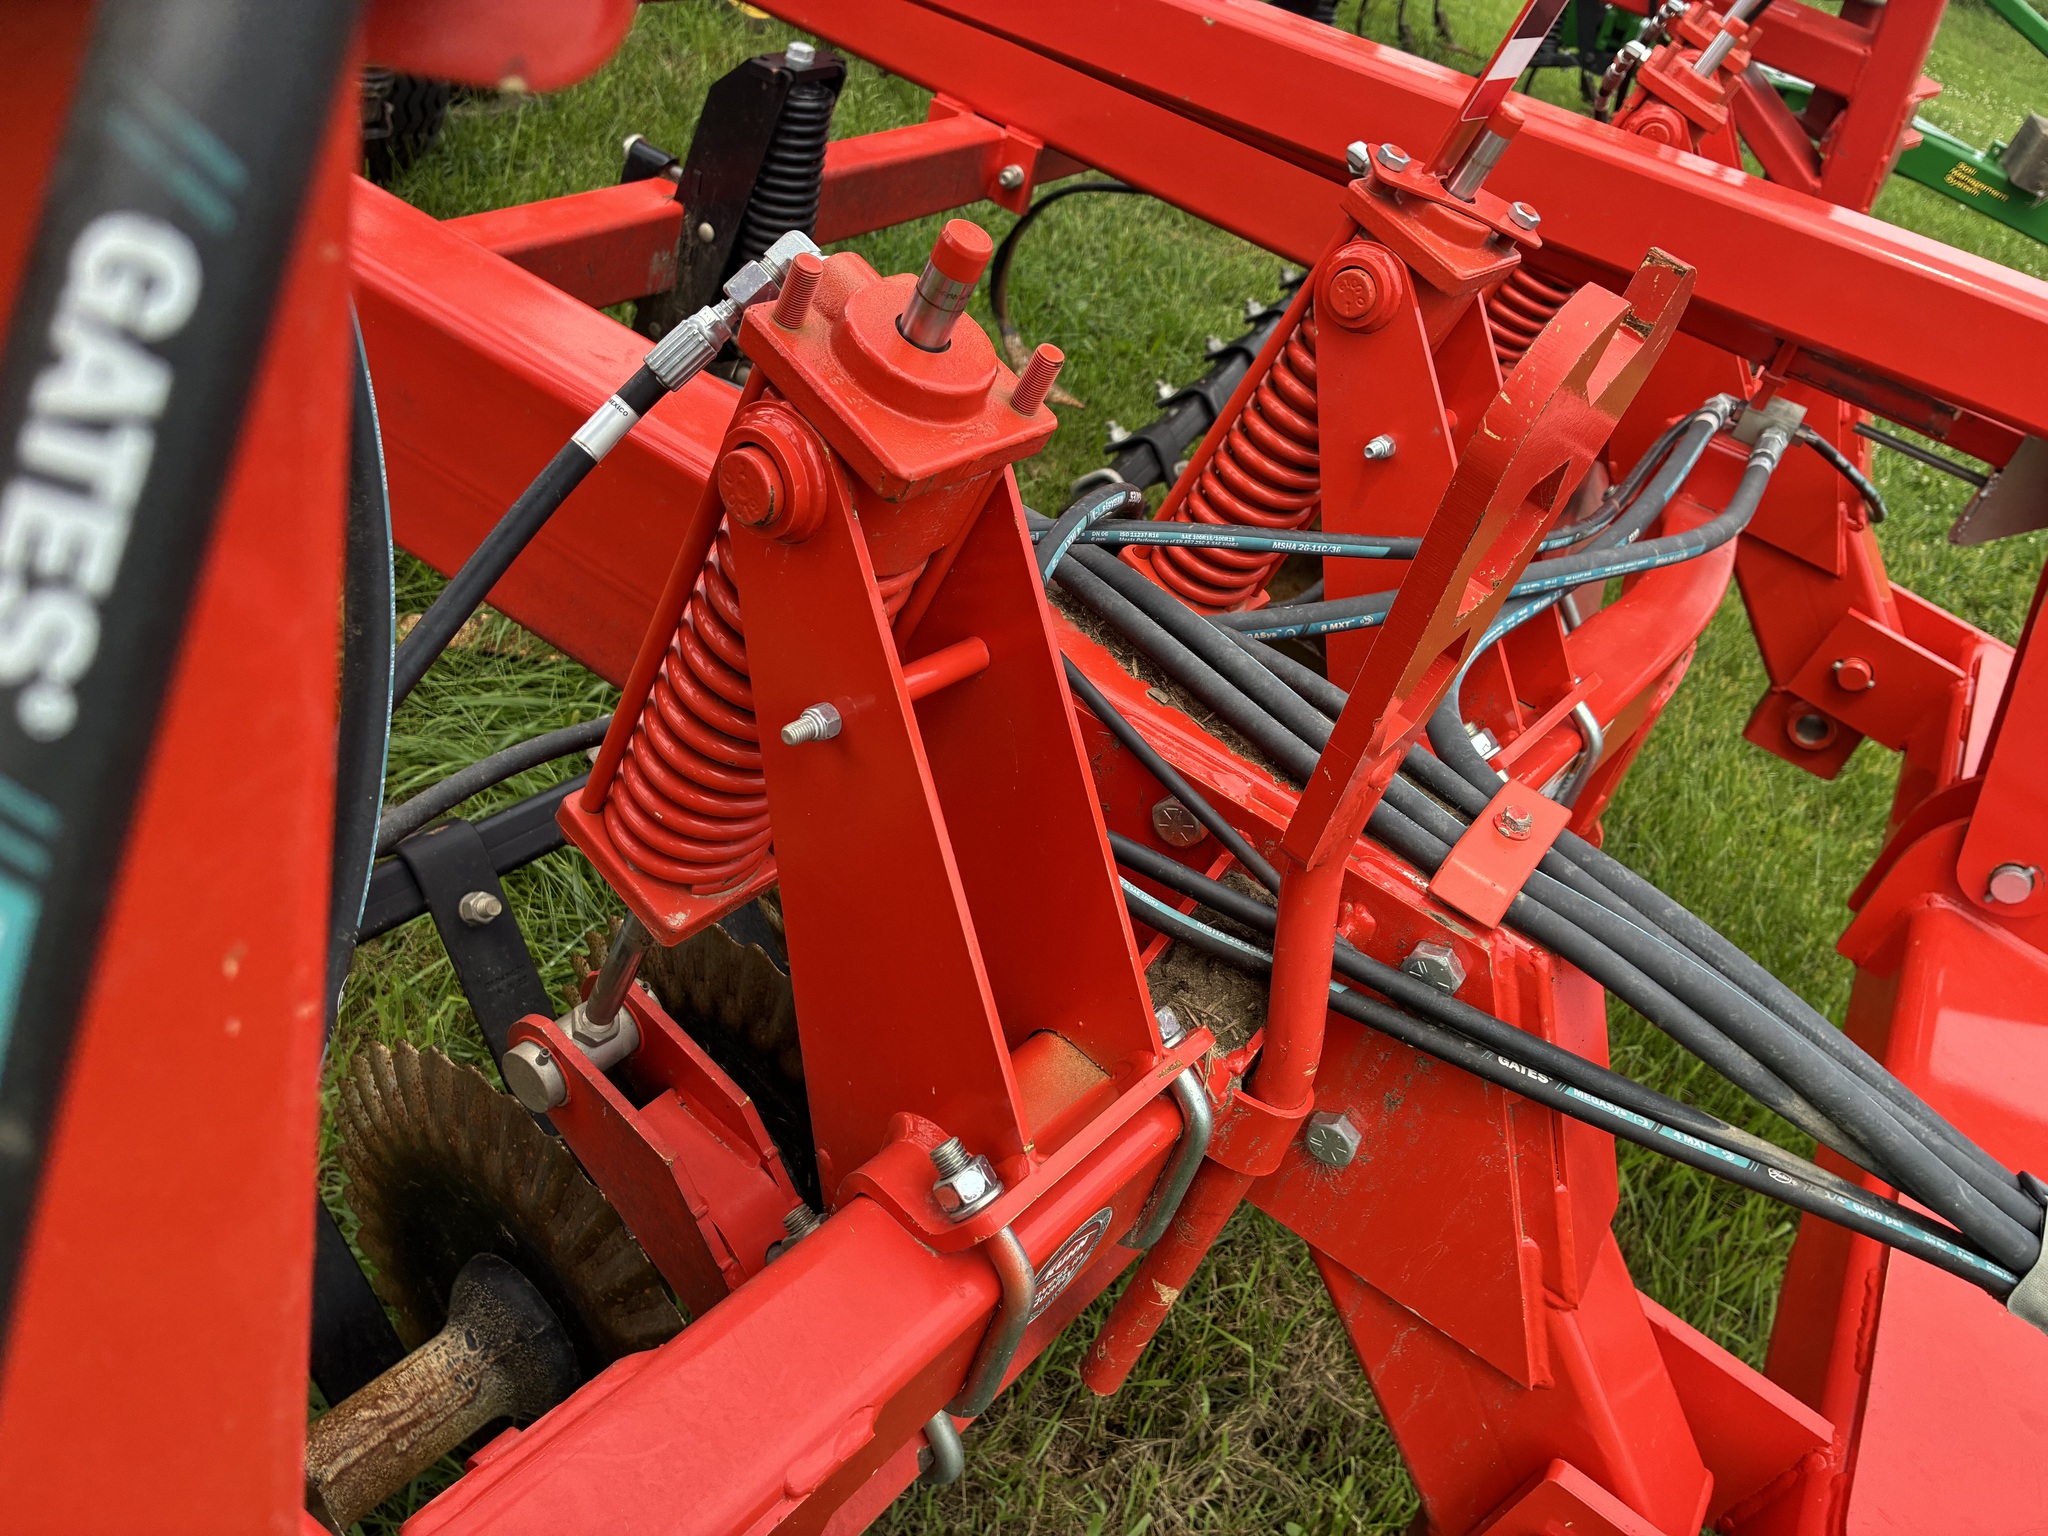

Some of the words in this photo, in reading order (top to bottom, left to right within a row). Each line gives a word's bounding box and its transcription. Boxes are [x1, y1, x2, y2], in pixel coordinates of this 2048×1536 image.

[1271, 541, 1298, 550] MSHA
[1320, 624, 1327, 632] 8
[1329, 620, 1351, 631] MXT
[1196, 920, 1227, 940] MSHA
[1497, 1055, 1550, 1085] GATES
[1573, 1087, 1627, 1117] MEGASys
[1672, 1130, 1682, 1141] 4
[1683, 1134, 1708, 1151] MXT
[1852, 1202, 1883, 1220] 6000
